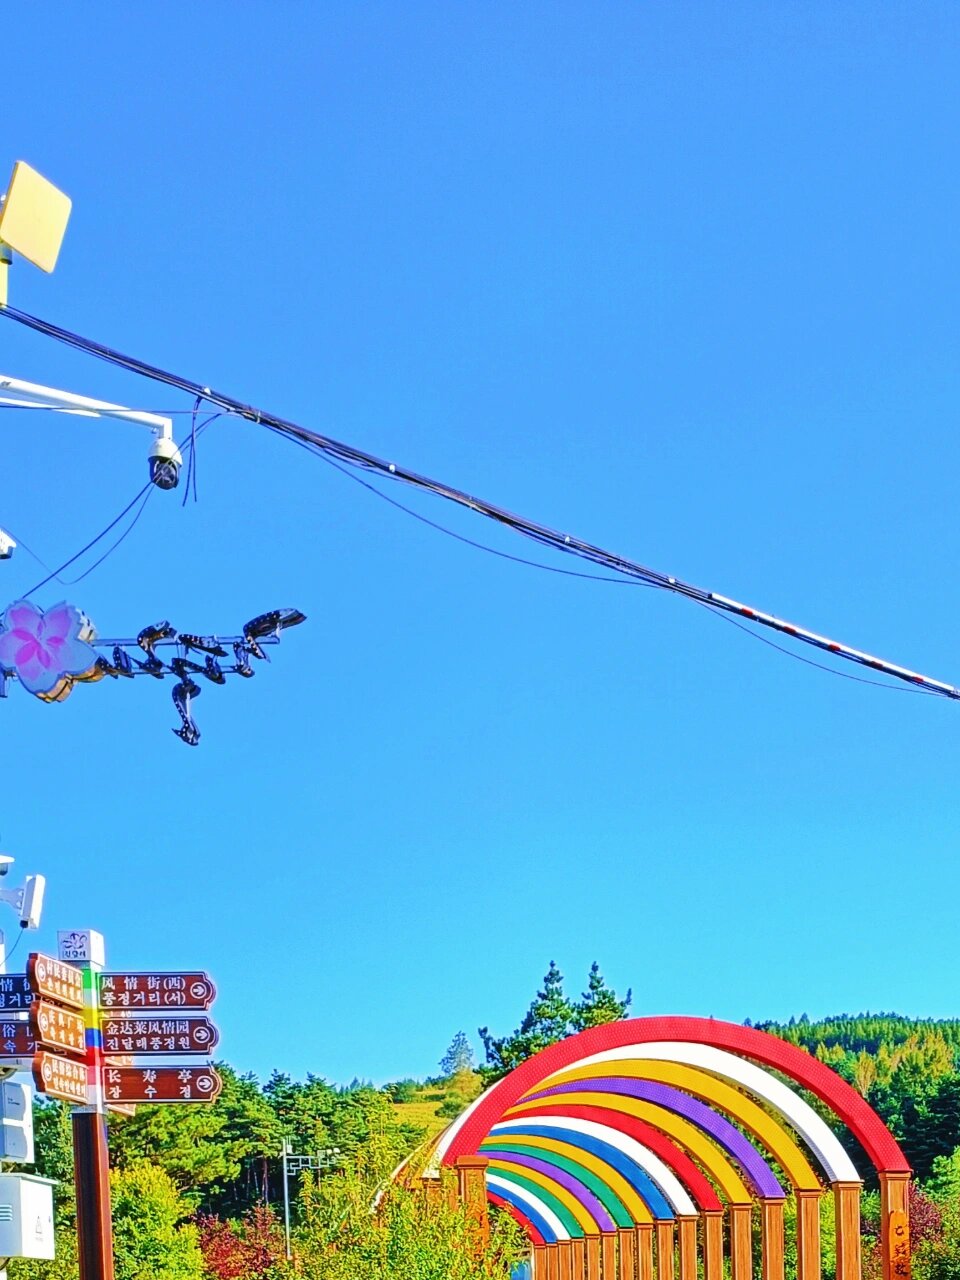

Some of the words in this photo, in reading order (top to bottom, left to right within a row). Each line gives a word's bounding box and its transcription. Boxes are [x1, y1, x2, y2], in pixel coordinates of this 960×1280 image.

[102, 976, 186, 990] 风情街(西)
[102, 991, 186, 1005] 풍정거리(서)
[106, 1020, 190, 1035] 金达莱风情园
[107, 1036, 190, 1050] 진달래풍정원
